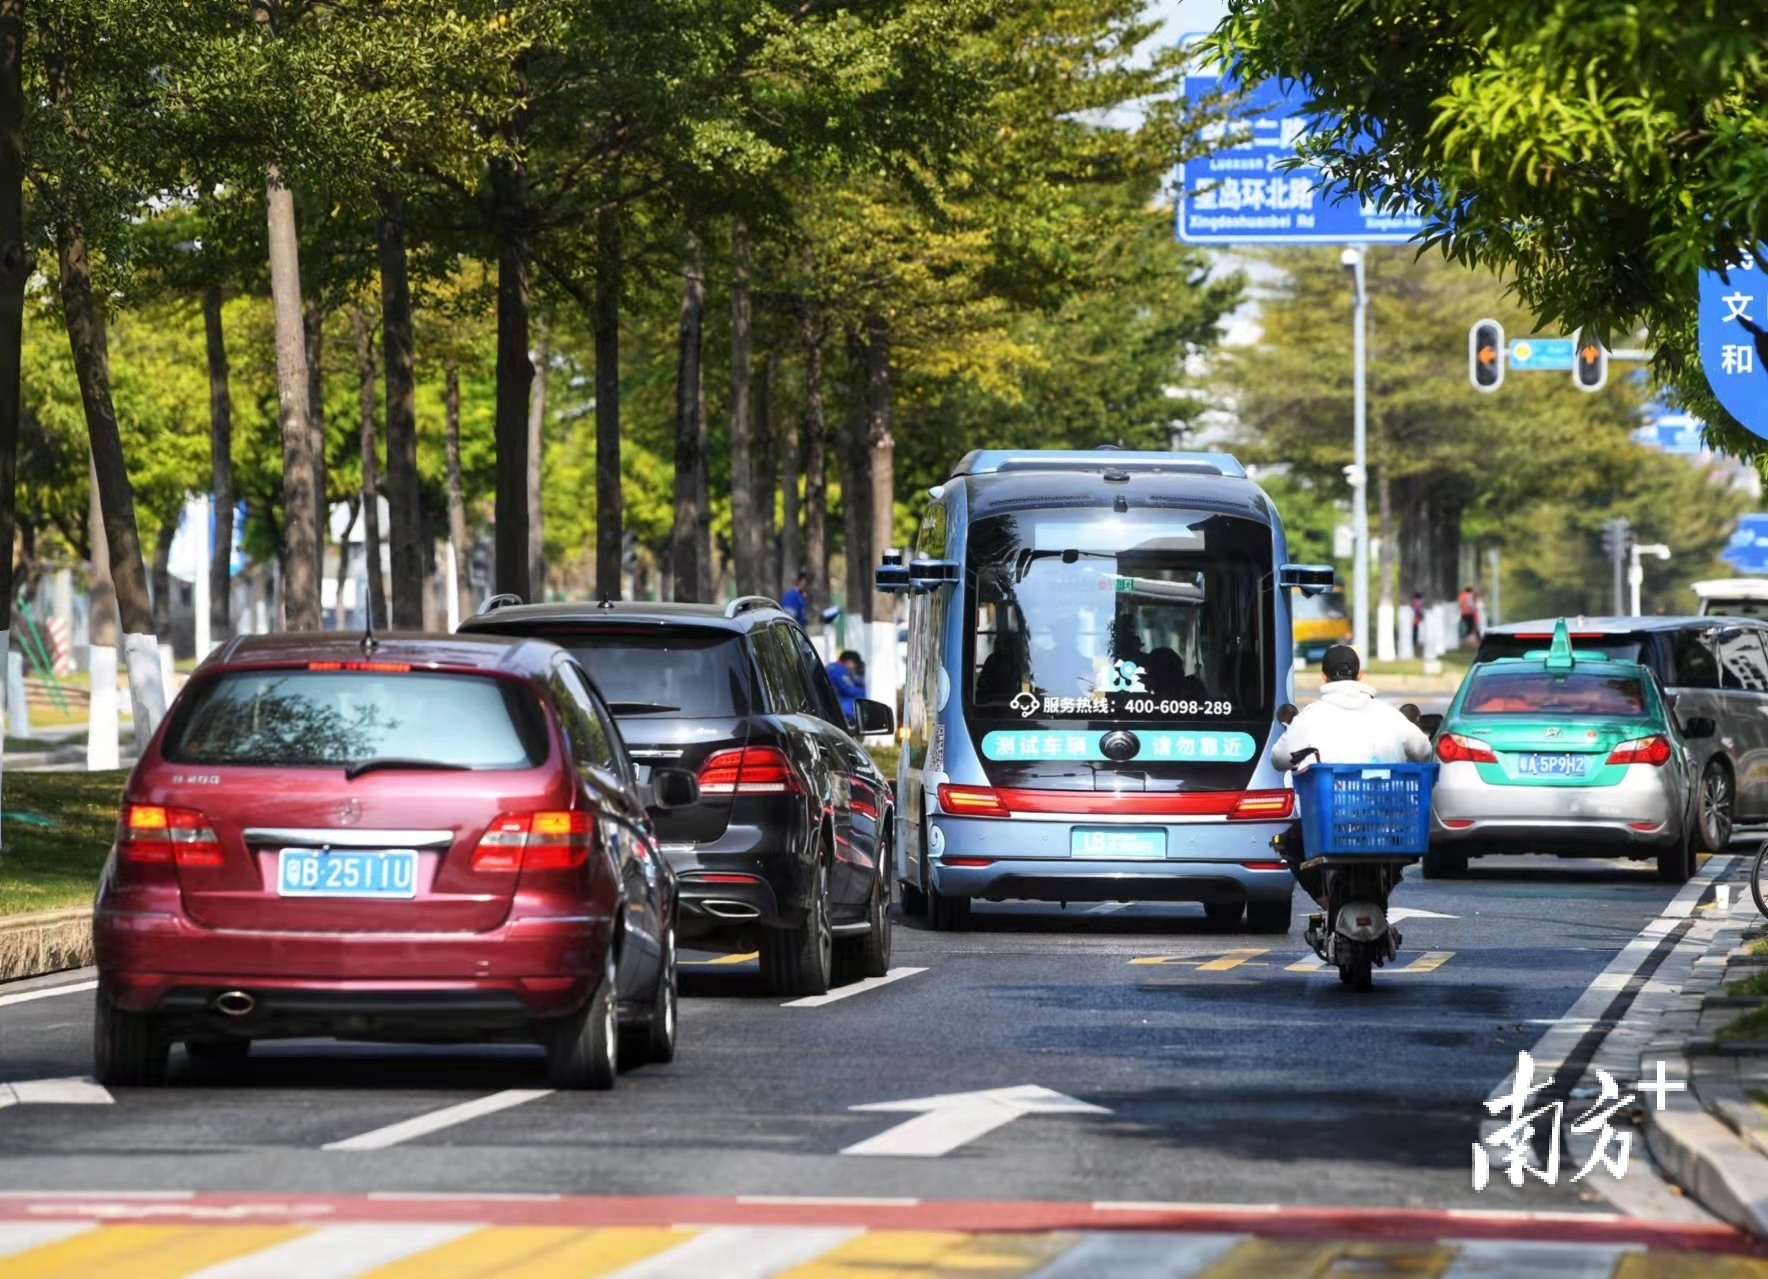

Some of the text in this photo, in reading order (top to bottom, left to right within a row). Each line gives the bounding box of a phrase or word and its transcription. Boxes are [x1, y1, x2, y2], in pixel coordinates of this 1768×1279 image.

[1721, 344, 1753, 375] 和
[995, 735, 1088, 756] 测试车辆
[1152, 735, 1243, 757] 请勿靠近
